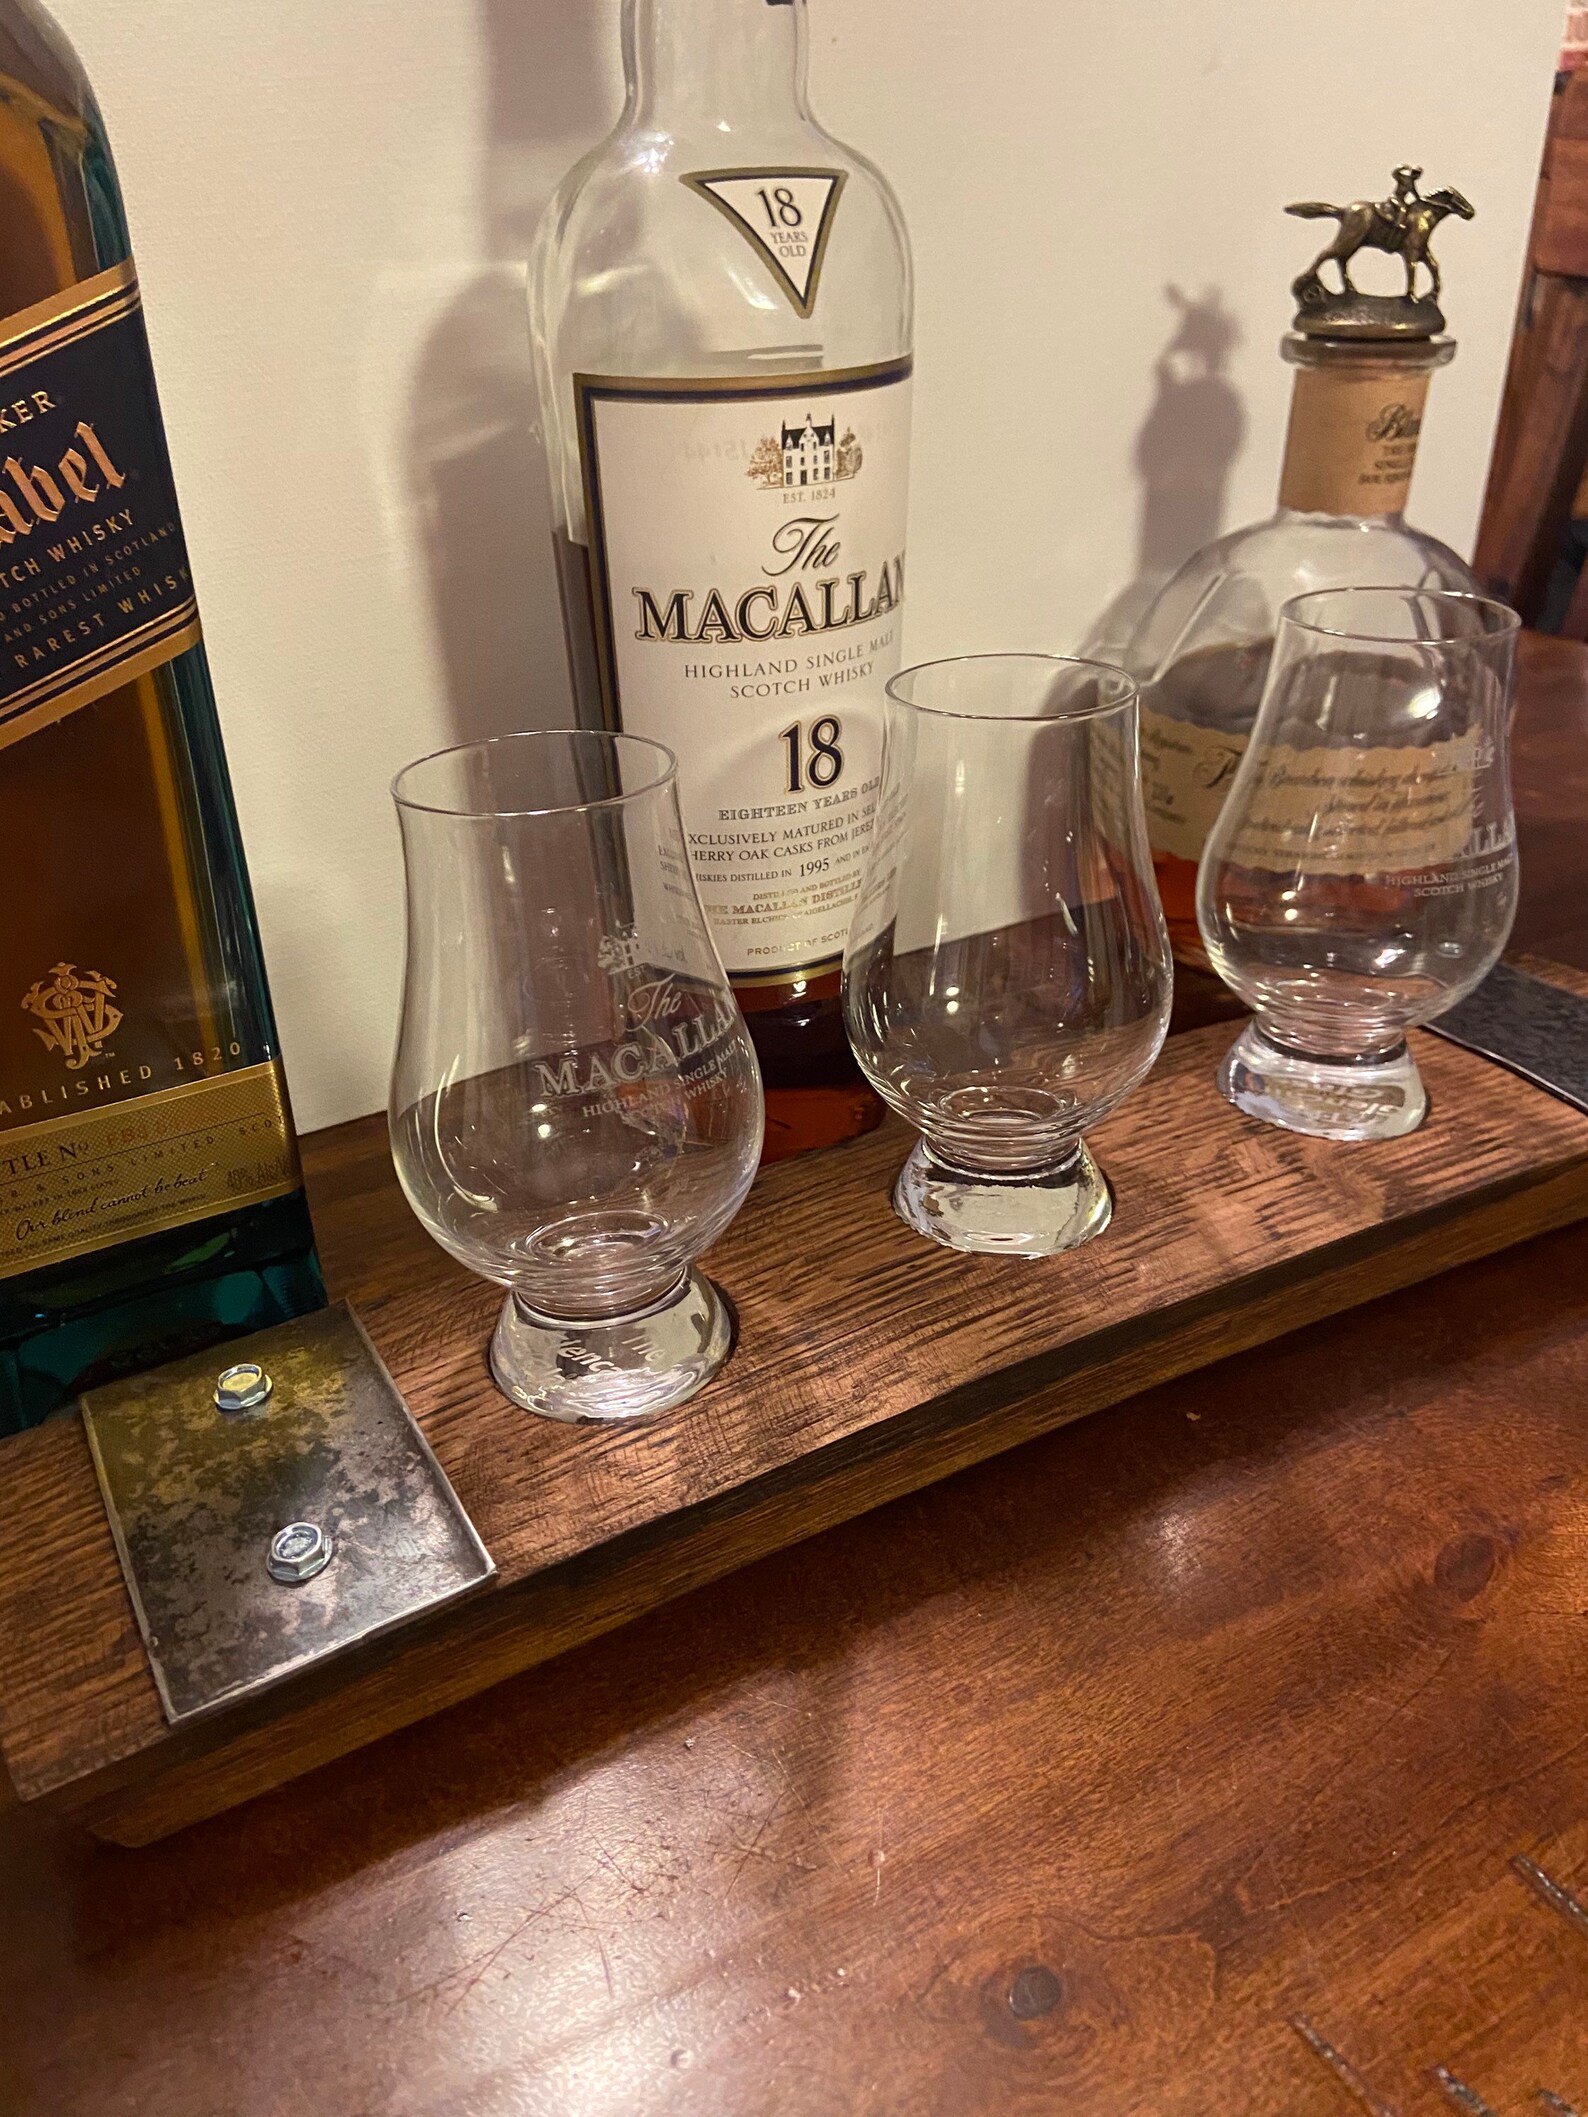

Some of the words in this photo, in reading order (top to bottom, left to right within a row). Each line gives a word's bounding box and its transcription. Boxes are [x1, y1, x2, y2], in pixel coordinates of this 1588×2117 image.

[757, 187, 802, 228] 18
[770, 231, 808, 243] YEARS
[779, 245, 806, 257] OLD
[783, 492, 806, 504] EST.
[811, 487, 836, 501] 1824
[47, 508, 134, 562] WHISKY
[761, 513, 840, 577] The
[11, 575, 76, 613] BOTTLED
[83, 562, 99, 577] IN
[104, 522, 176, 565] SCOTLAND
[3, 623, 32, 642] AND
[38, 600, 77, 625] SONS
[82, 566, 141, 602] LIMITED
[14, 613, 105, 668] RAREST
[684, 659, 798, 679] HIGHLAND
[806, 645, 863, 670] SINGLE
[730, 678, 810, 699] SCOTCH
[819, 660, 875, 689] WHISKY
[778, 714, 845, 796] 18
[718, 802, 808, 821] EIGHTEEN
[813, 788, 858, 810] YEARS
[688, 831, 777, 845] XCLUSIVELY
[782, 816, 844, 841] MATURED
[847, 811, 859, 825] IN
[738, 848, 769, 861] OAK
[773, 841, 814, 858] CASKS
[816, 832, 849, 851] FROM
[730, 868, 778, 882] DISTILLED
[781, 868, 792, 877] IN
[799, 857, 830, 878] 1995
[1413, 884, 1465, 898] SCOTCH
[624, 973, 683, 1031] The
[0, 1065, 152, 1115] ABLISHED
[173, 1041, 241, 1071] 1820
[675, 1060, 716, 1088] SINGLE
[684, 1068, 728, 1100] WHISKY
[62, 1163, 114, 1184] SONS
[131, 1136, 214, 1166] LIMITED
[16, 1217, 47, 1241] Our
[52, 1196, 99, 1226] blend
[101, 1183, 152, 1211] cannot
[155, 1177, 171, 1194] be
